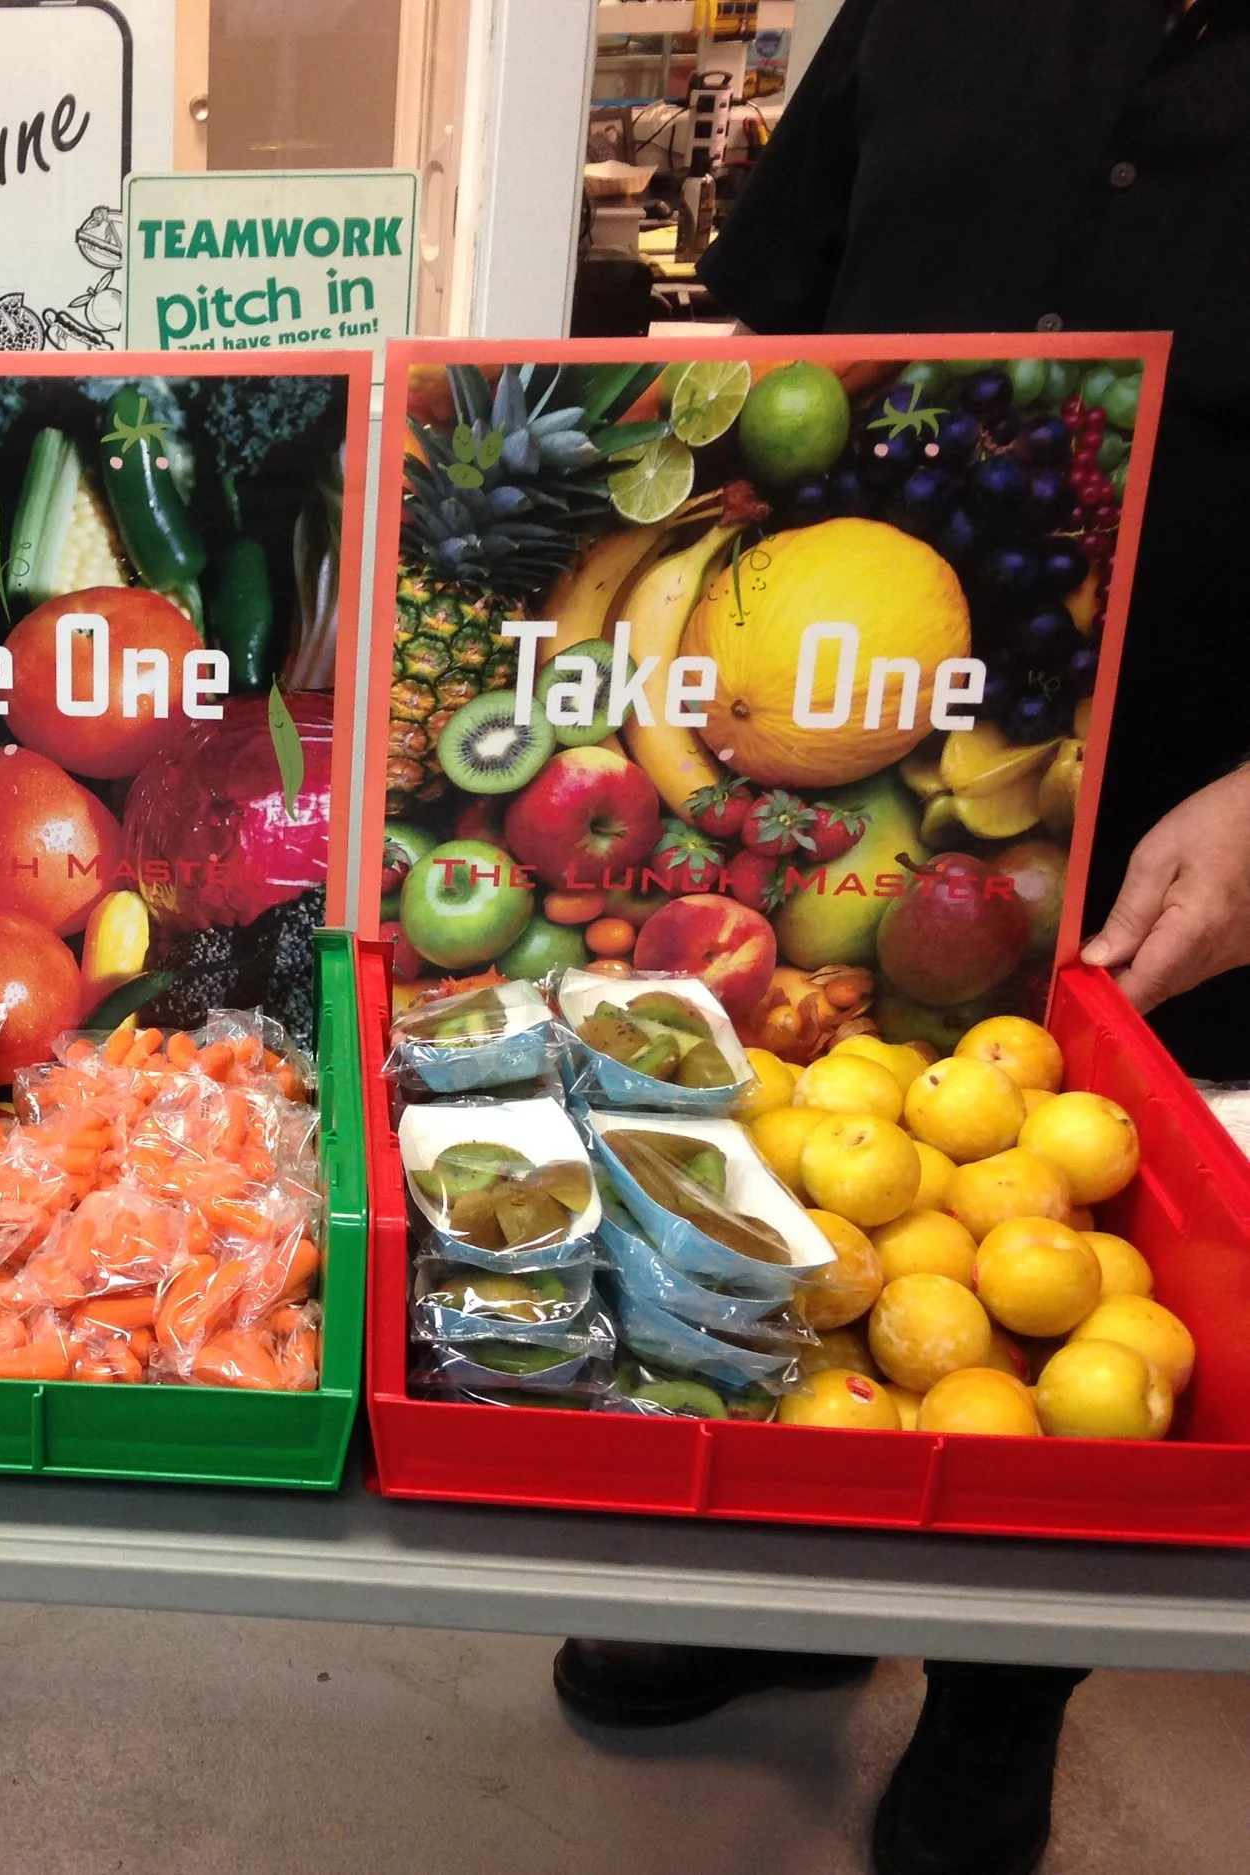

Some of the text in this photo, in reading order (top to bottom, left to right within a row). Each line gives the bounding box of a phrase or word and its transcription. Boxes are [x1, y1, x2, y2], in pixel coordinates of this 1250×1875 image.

[138, 216, 403, 259] TEAMWORK
[156, 267, 374, 350] pitch in
[223, 333, 271, 350] have
[278, 326, 331, 345] more
[338, 317, 379, 337] fun!
[55, 613, 230, 720] One
[500, 620, 988, 731] Take One
[784, 866, 1016, 900] MASTER
